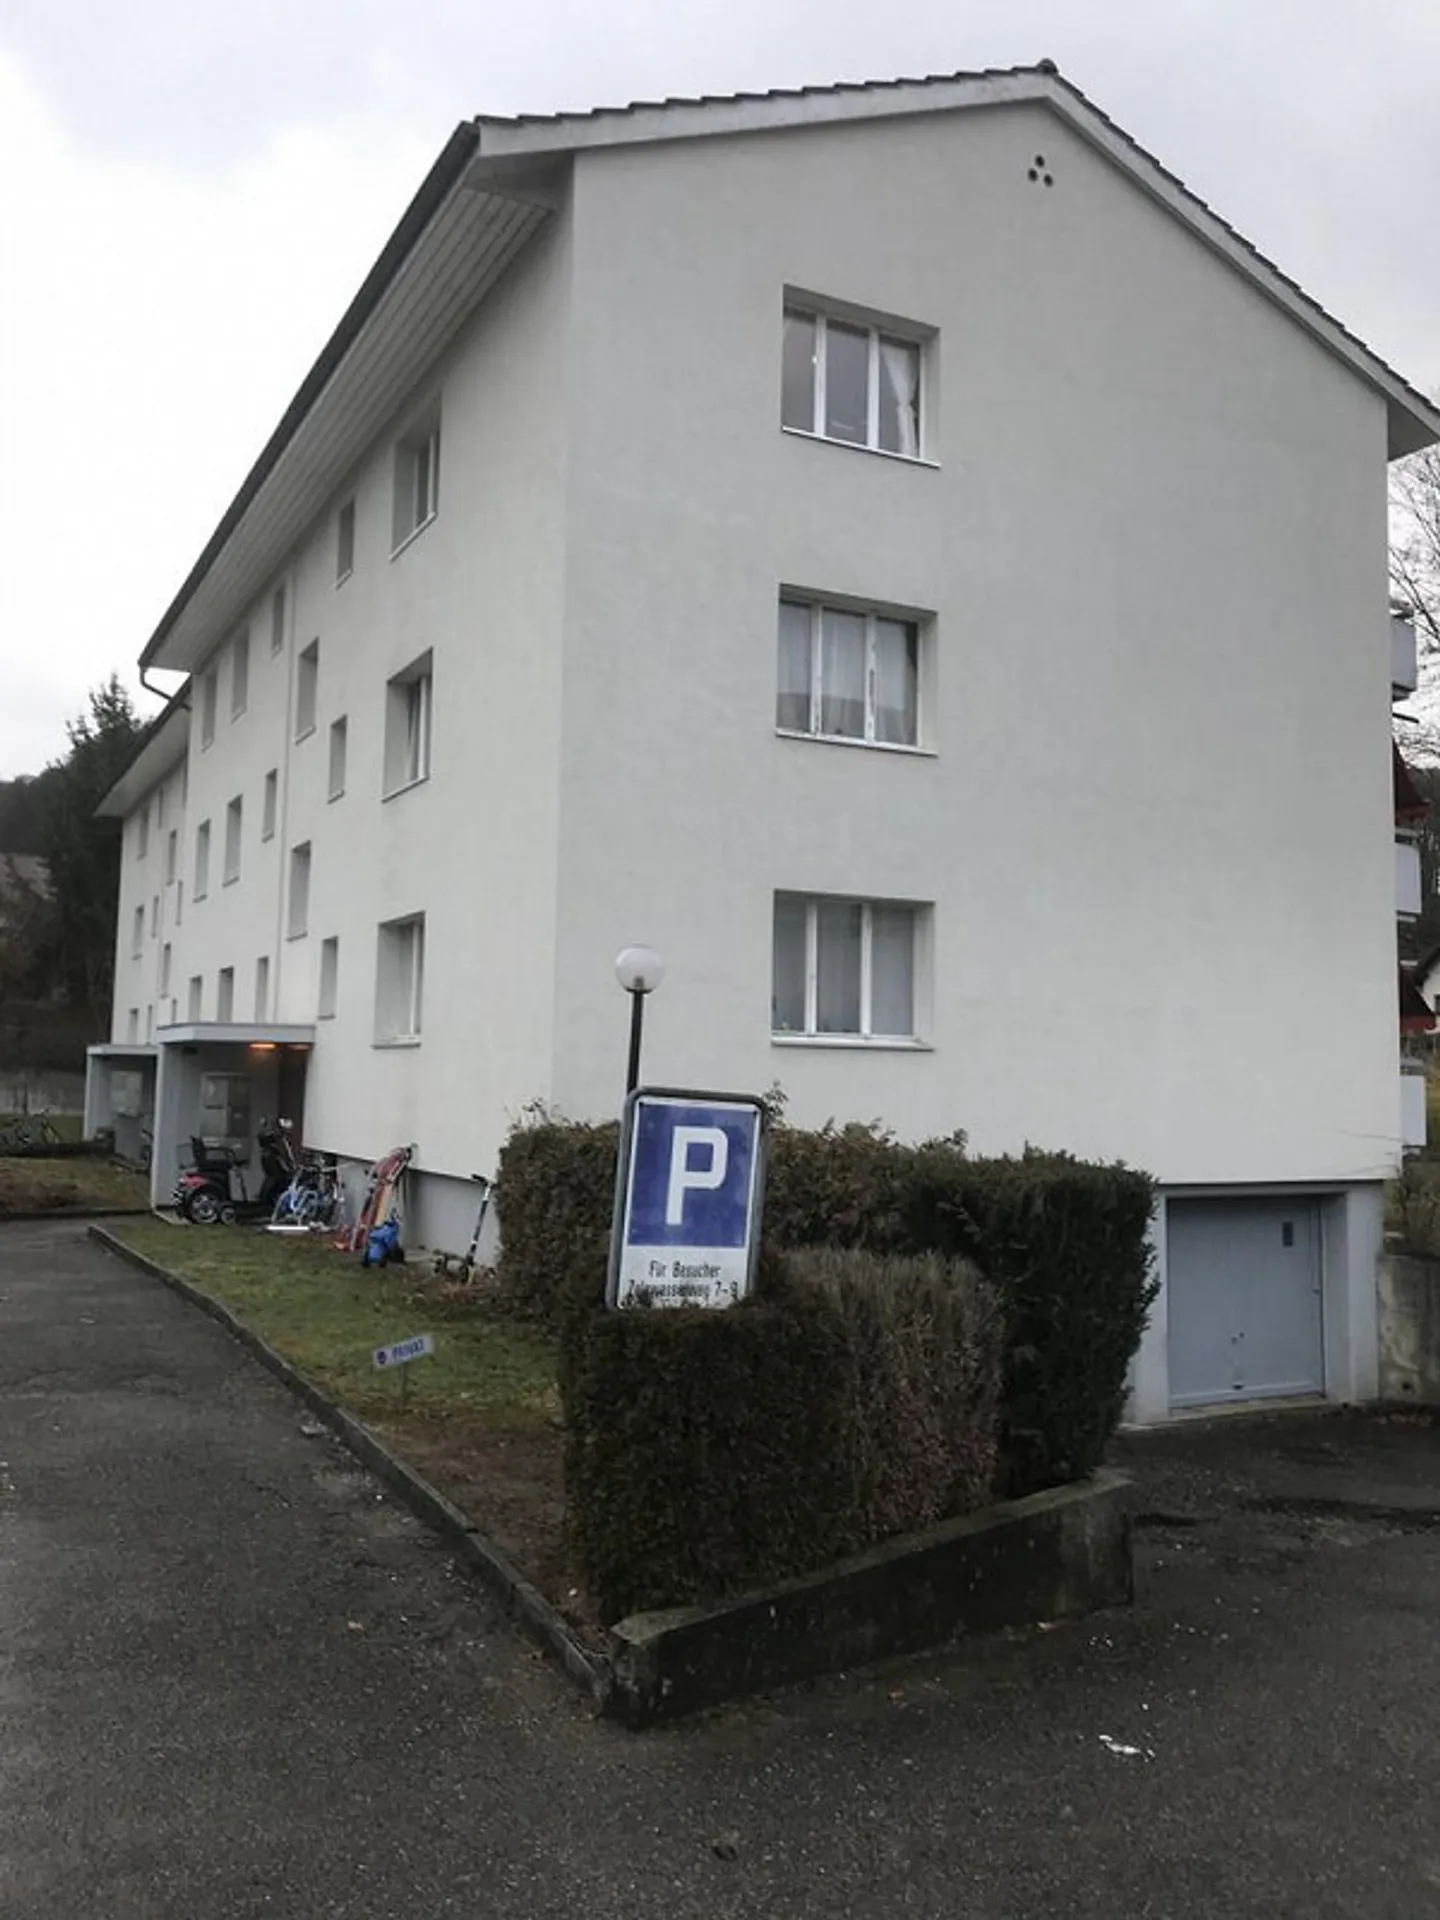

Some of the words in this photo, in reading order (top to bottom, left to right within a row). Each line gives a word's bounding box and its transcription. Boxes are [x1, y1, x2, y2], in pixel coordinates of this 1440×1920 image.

[667, 1126, 728, 1226] P
[649, 1260, 667, 1278] Für
[673, 1260, 721, 1279] Besucher
